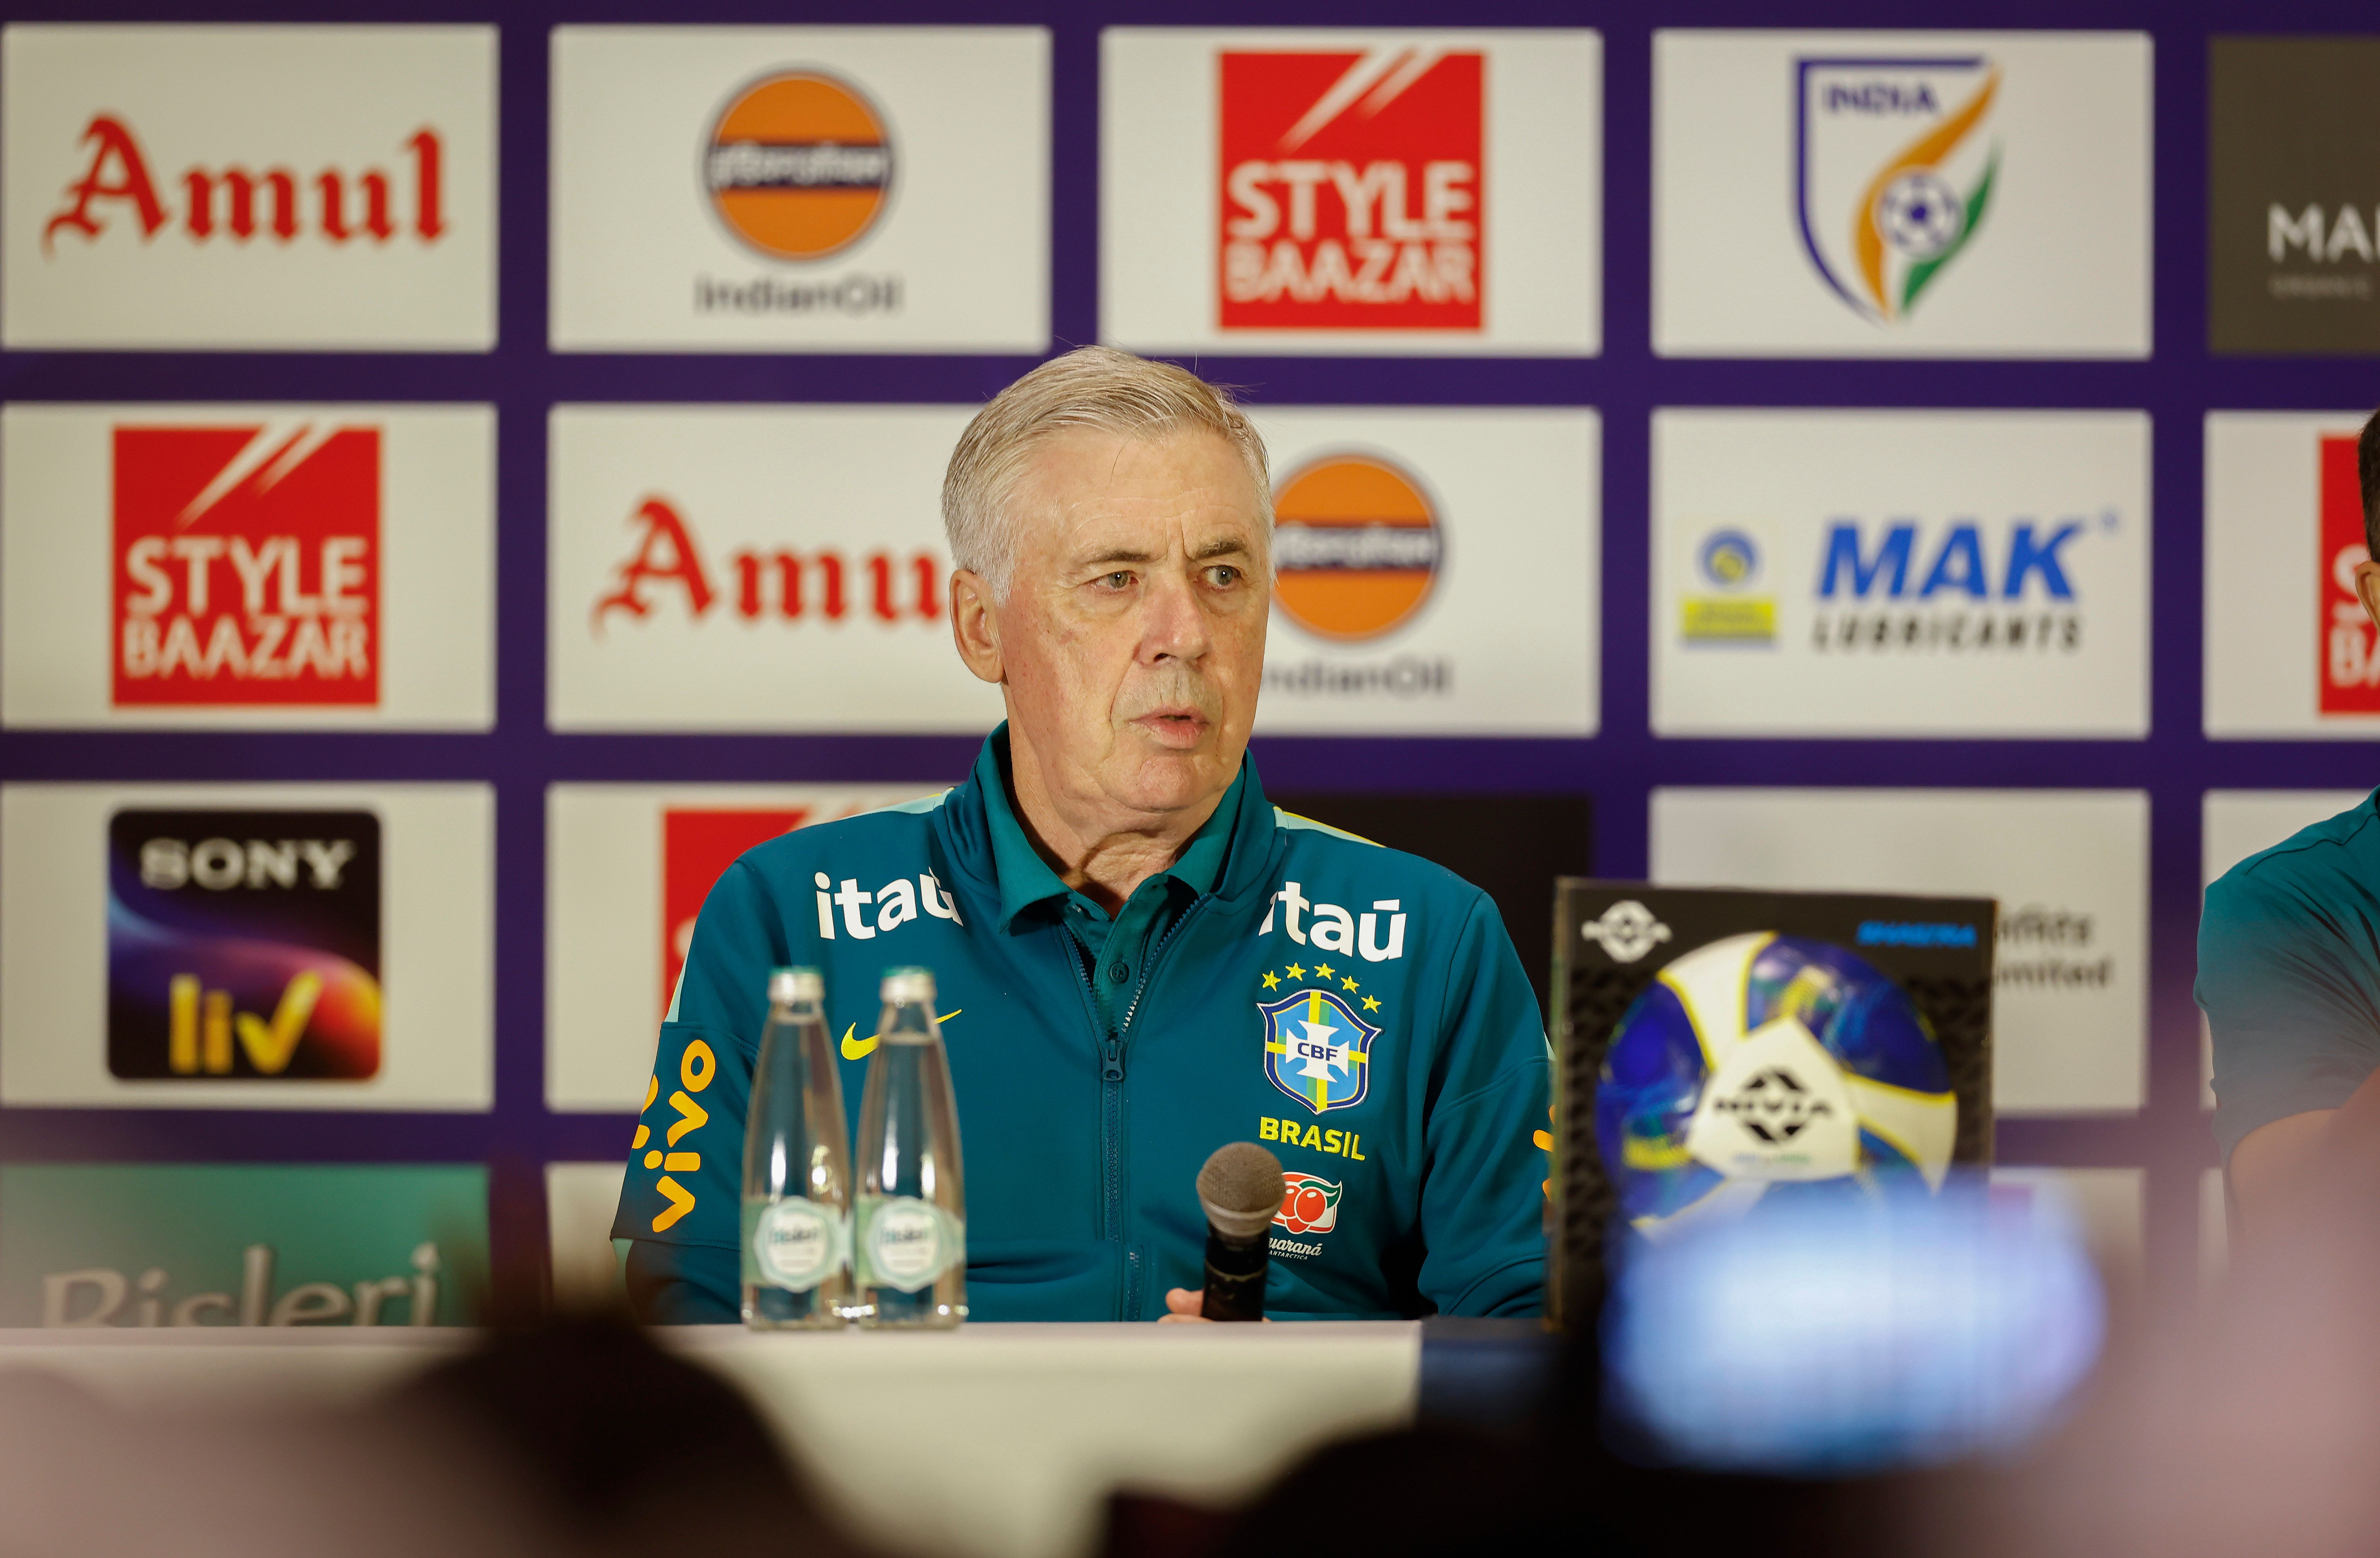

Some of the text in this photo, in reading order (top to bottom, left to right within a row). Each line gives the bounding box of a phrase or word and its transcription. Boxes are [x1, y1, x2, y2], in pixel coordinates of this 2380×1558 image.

[1823, 82, 1939, 116] INDIA
[42, 111, 448, 261] Amul
[1225, 161, 1474, 241] STYLE
[2268, 202, 2380, 264] MA
[695, 274, 904, 316] IndianOil
[1223, 239, 1476, 304] BAAZAR
[125, 535, 369, 617] STYLE
[589, 493, 945, 643] Amu
[1815, 519, 2086, 600] MAK
[122, 615, 369, 680] BAAZAR
[1812, 612, 2083, 652] LUBRICANTS
[1261, 657, 1453, 697] ndianOil
[140, 837, 356, 890] SONY
[814, 866, 964, 940] itaú
[1297, 1042, 1338, 1061] CBF
[644, 1039, 716, 1233] vivo
[1259, 1116, 1366, 1161] BRASIL
[1268, 1237, 1323, 1256] uaraná
[1268, 1250, 1308, 1260] ANTARCTICA
